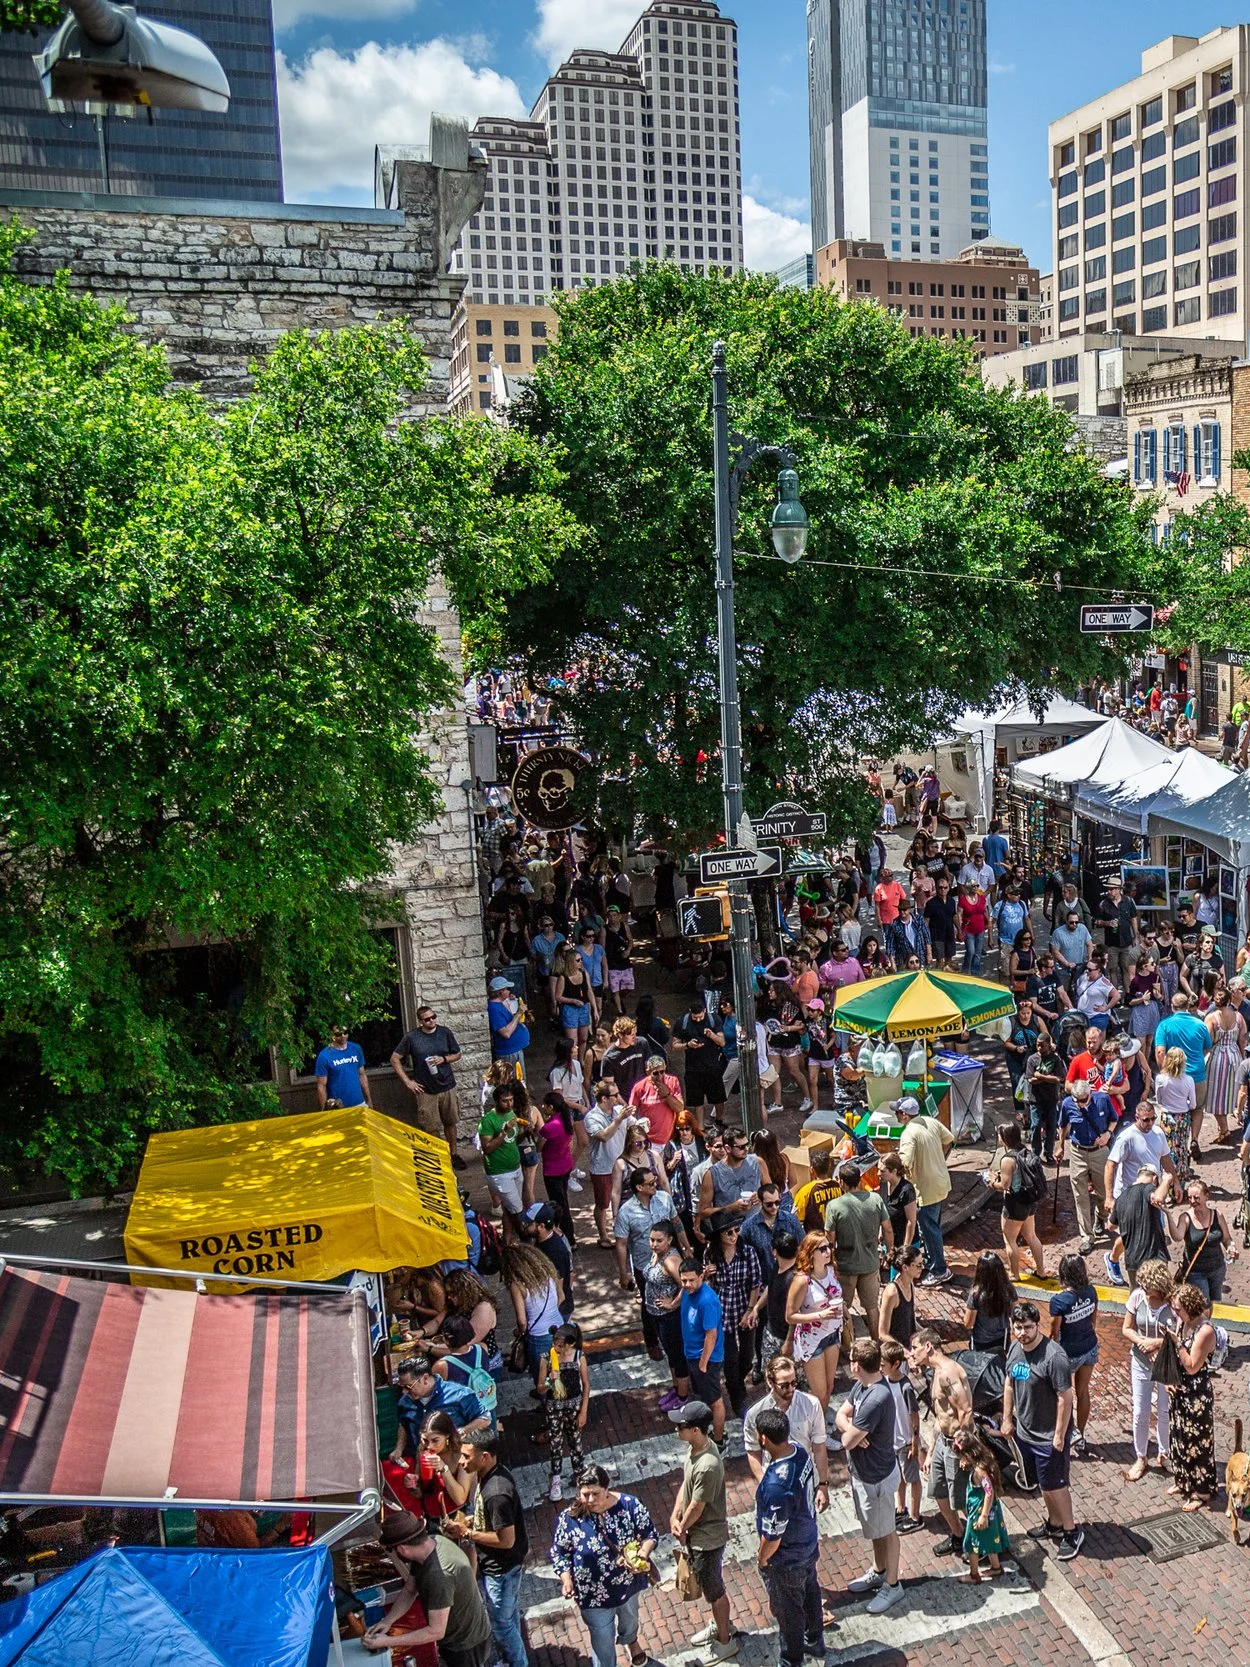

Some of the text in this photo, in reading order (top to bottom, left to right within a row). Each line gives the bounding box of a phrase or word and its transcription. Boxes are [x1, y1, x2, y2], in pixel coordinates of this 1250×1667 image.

[1088, 613, 1132, 624] ONE WAY
[709, 857, 758, 874] ONE WAY
[966, 1004, 1015, 1027] LEMONADE
[891, 1022, 962, 1040] LEMONADE
[814, 1187, 842, 1204] GWYNN
[179, 1223, 324, 1261] ROASTED
[213, 1250, 295, 1278] CORN
[775, 1462, 790, 1480] 4
